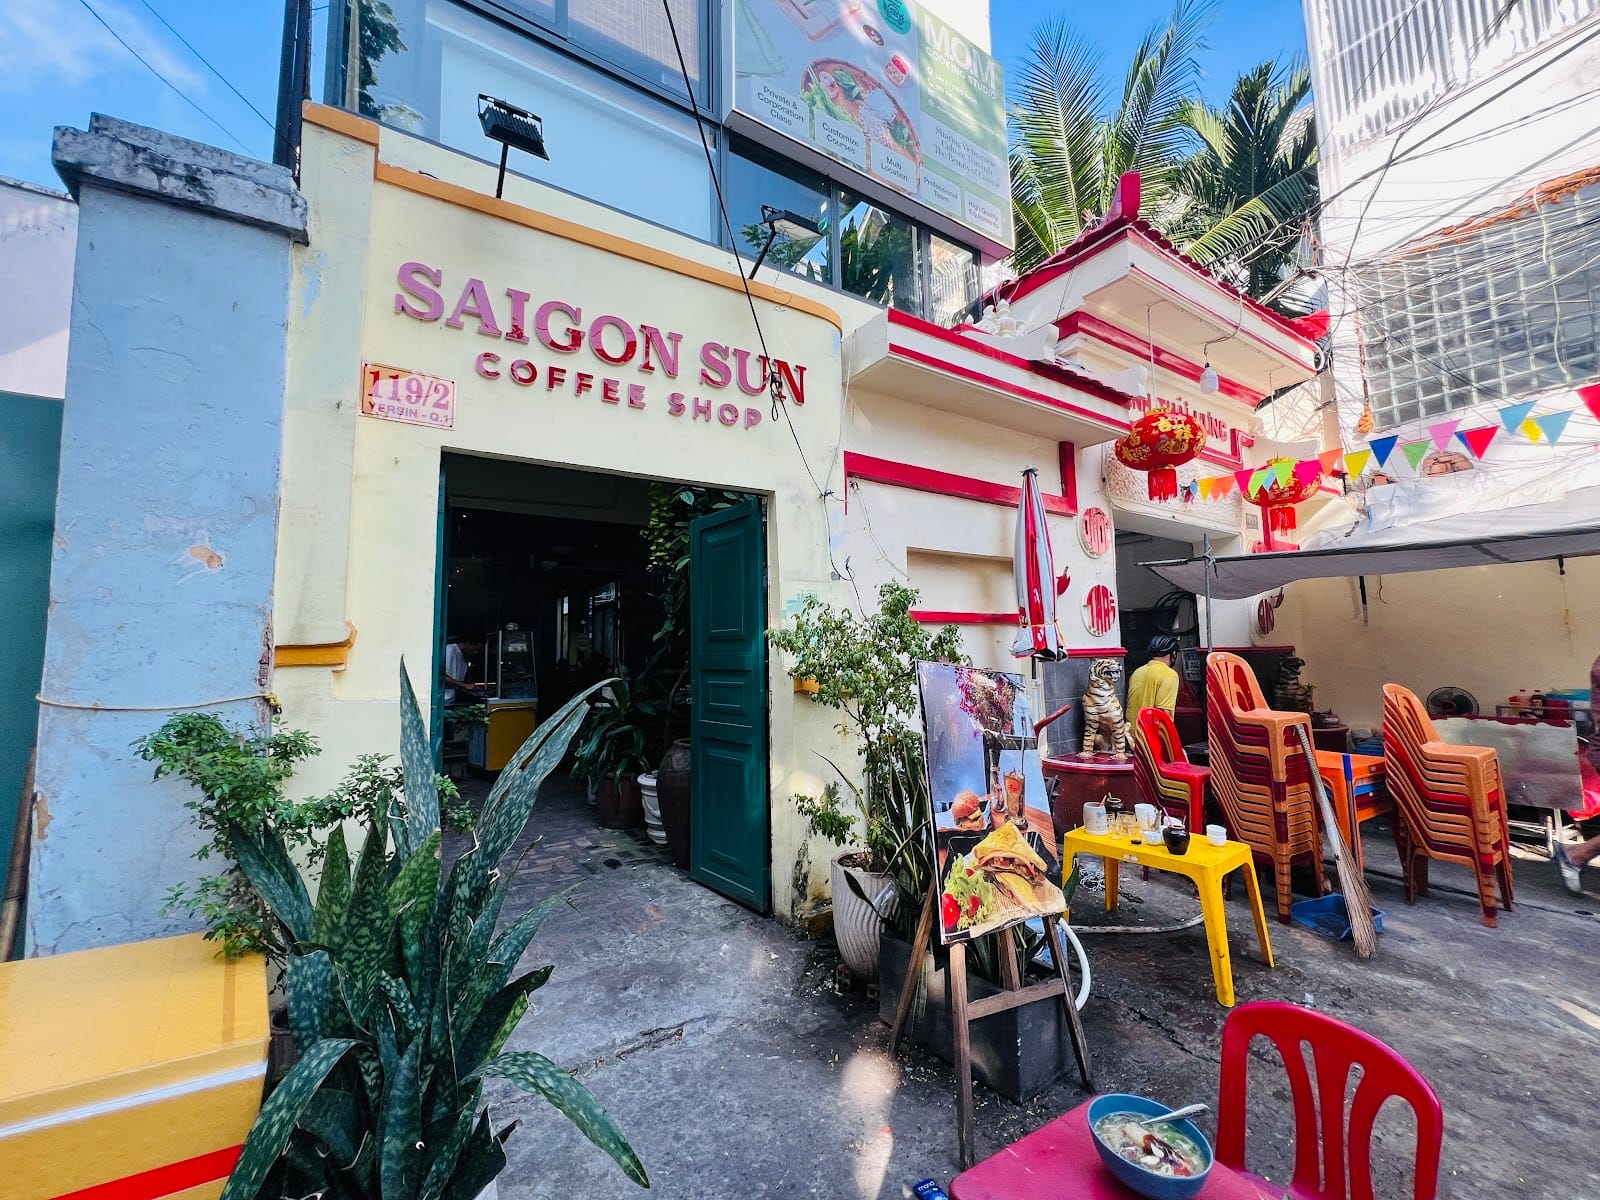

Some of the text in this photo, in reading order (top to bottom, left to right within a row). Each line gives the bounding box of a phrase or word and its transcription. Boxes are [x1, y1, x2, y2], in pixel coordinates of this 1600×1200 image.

[925, 15, 996, 90] MOM
[926, 47, 966, 79] COOKING
[968, 75, 996, 100] STUDIO
[757, 92, 804, 123] Corporation
[763, 85, 798, 110] Private &
[770, 108, 792, 126] Class
[822, 121, 860, 148] Customize
[826, 134, 857, 156] Courses
[880, 162, 908, 182] Location
[886, 155, 902, 170] Multi
[923, 176, 958, 201] Professional
[393, 261, 808, 406] SAIGON SUN
[368, 369, 450, 411] 119/2
[475, 351, 763, 431] COFFEE SHOP
[368, 401, 419, 419] YERSIN
[430, 412, 449, 424] Q.1
